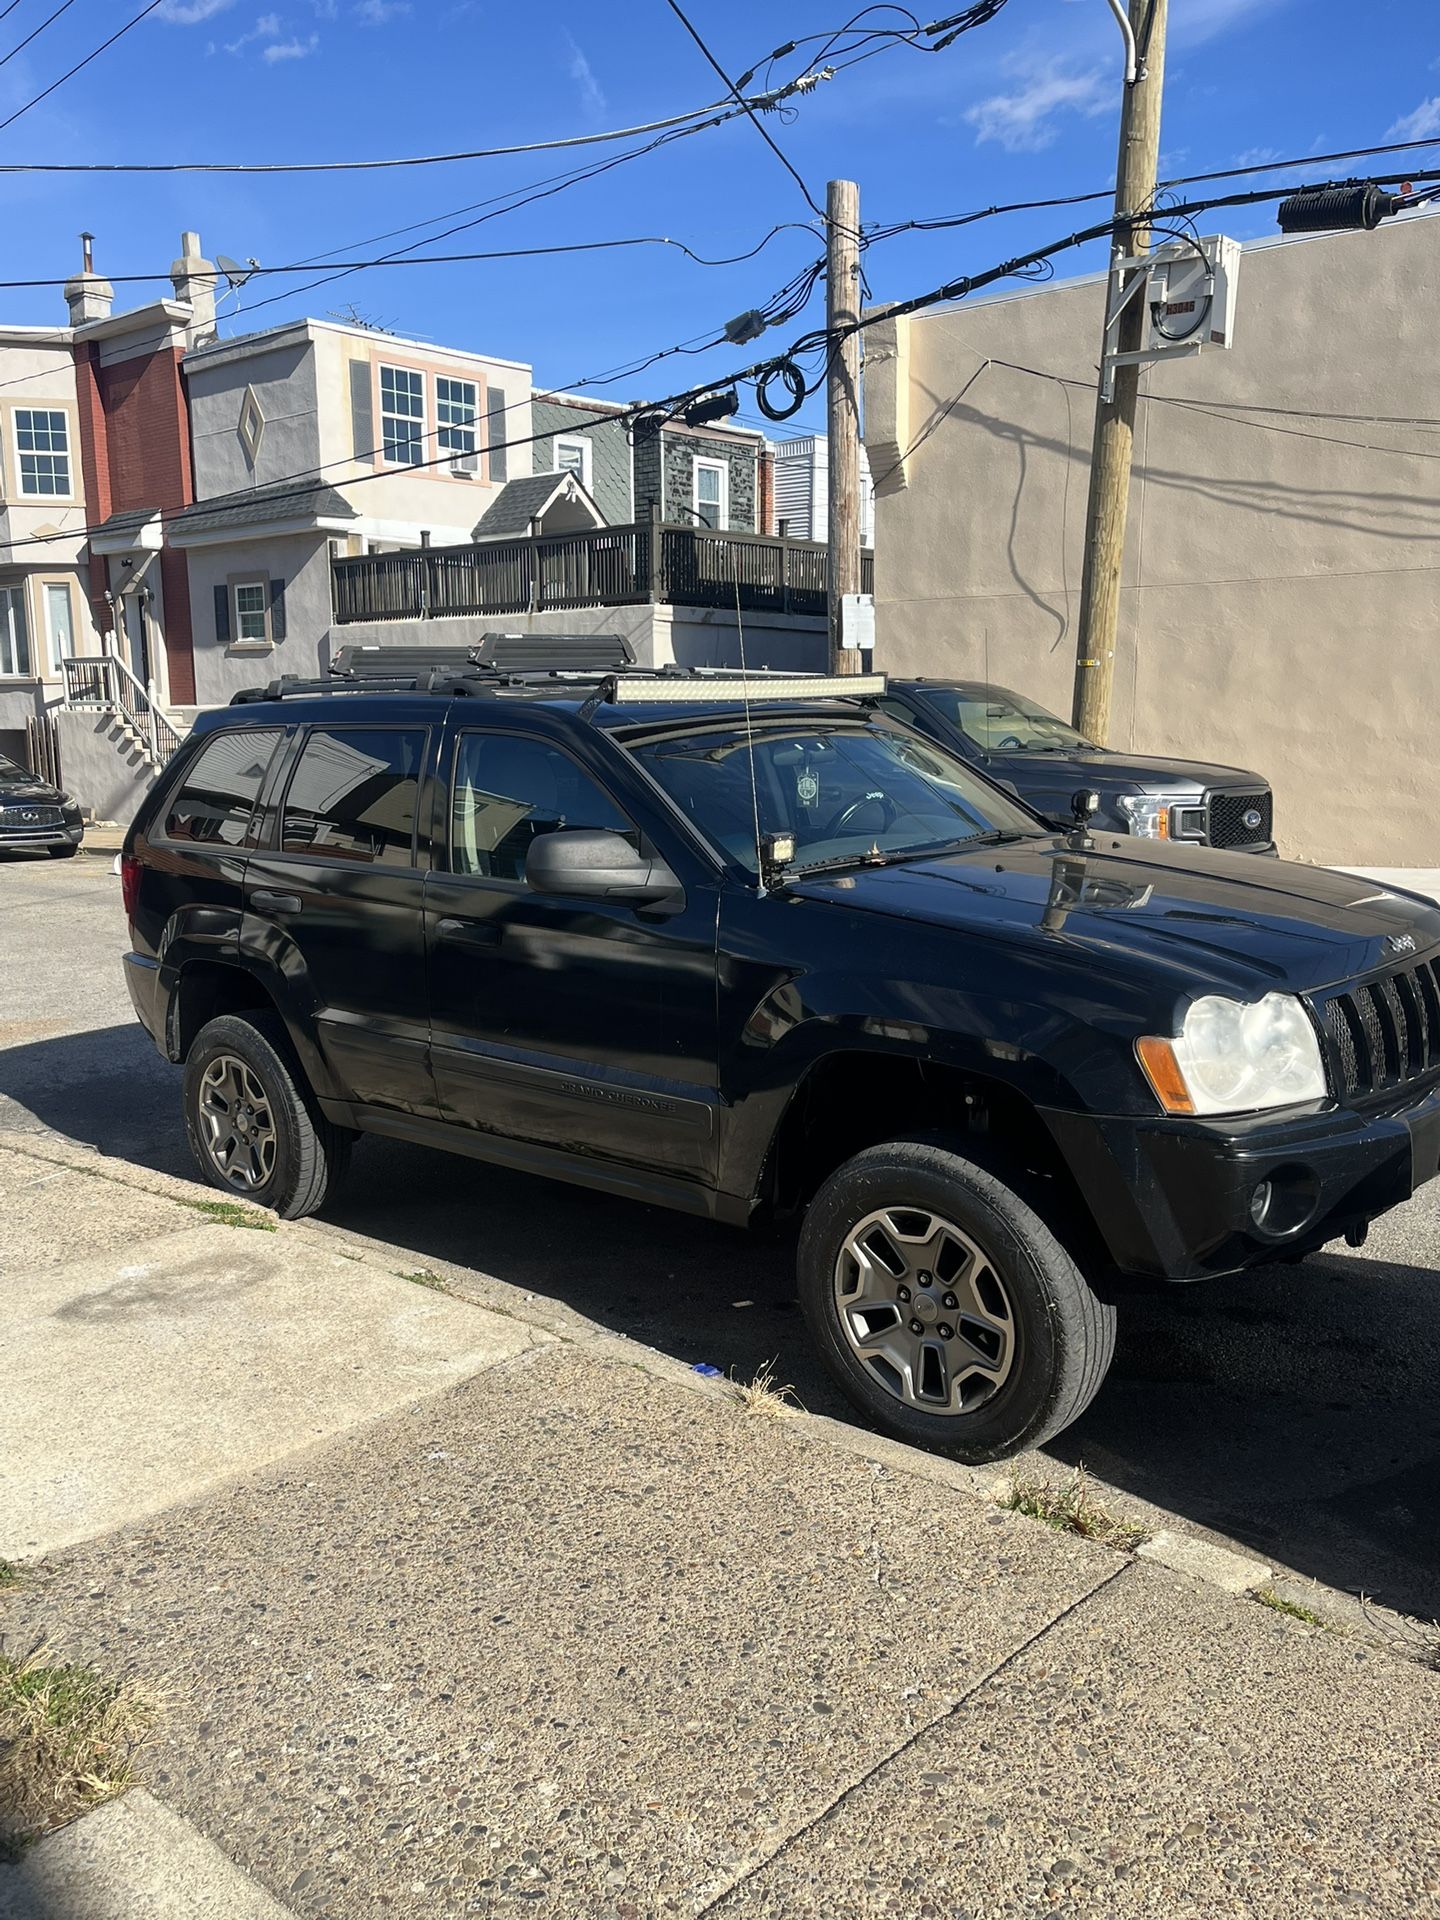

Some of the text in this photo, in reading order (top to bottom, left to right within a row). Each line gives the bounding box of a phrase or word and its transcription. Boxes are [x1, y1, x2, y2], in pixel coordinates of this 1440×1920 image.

[1386, 934, 1416, 952] Jeep
[560, 1081, 677, 1113] GRAND CHEROKEE
